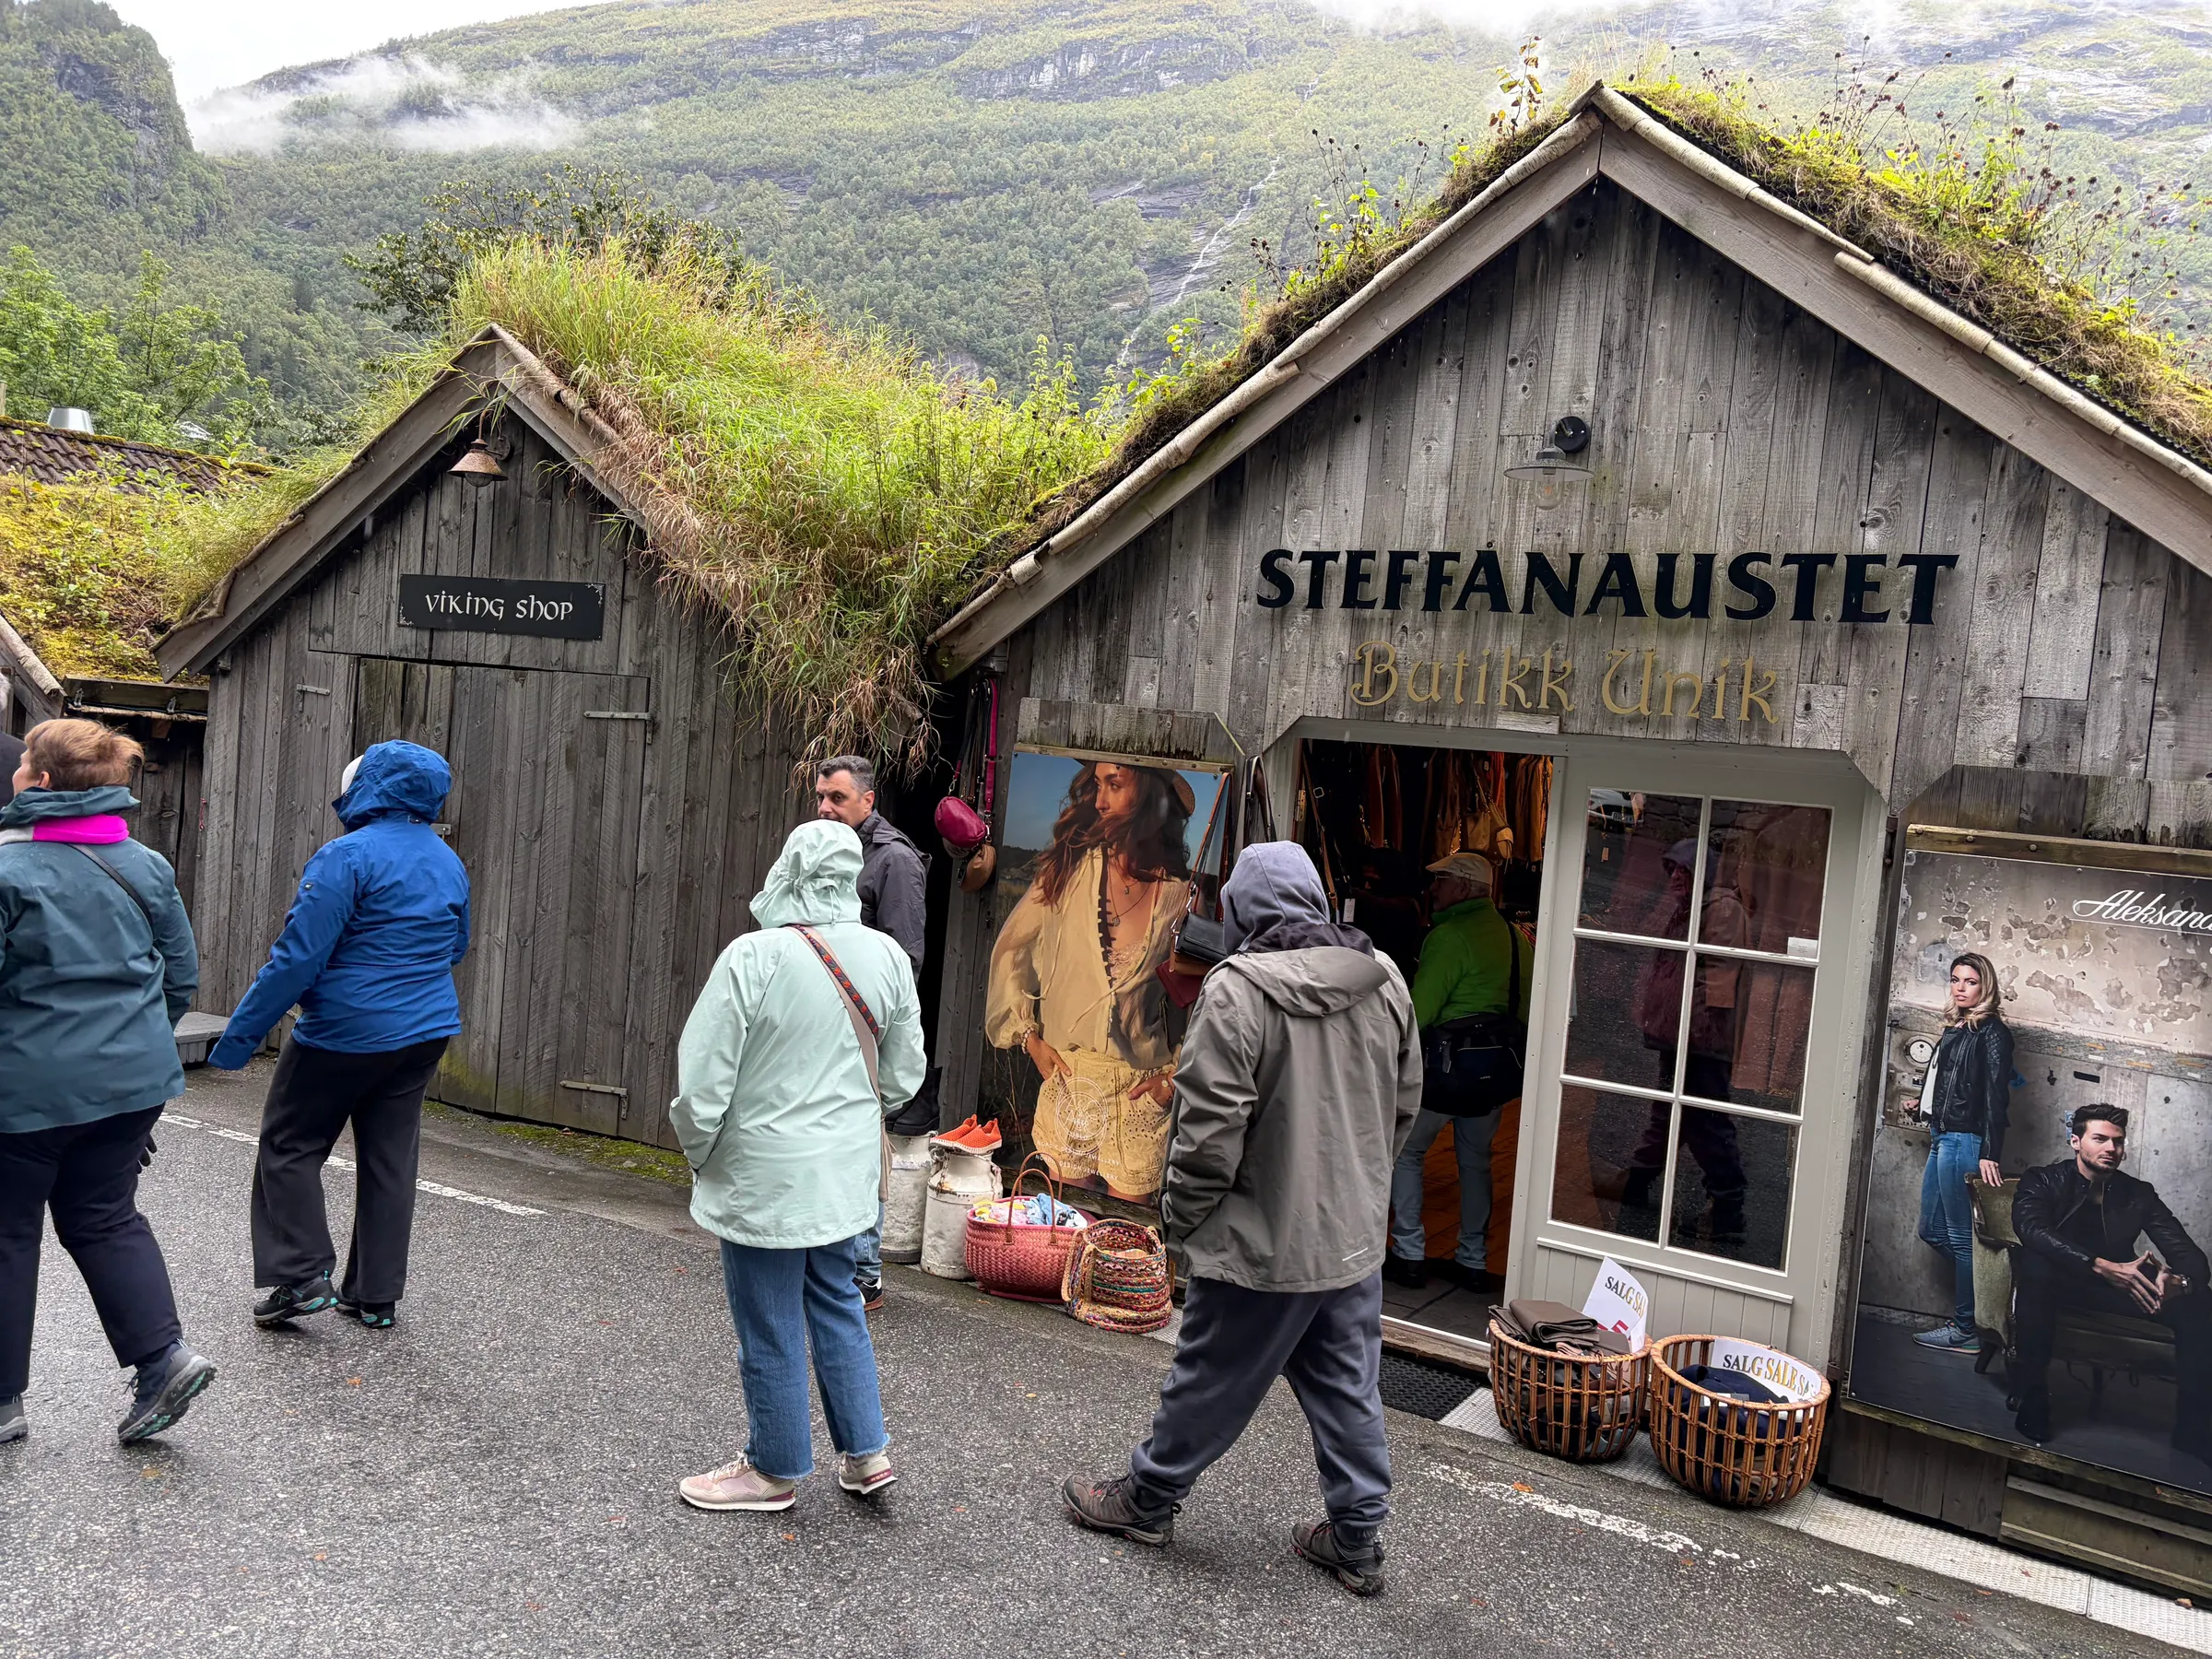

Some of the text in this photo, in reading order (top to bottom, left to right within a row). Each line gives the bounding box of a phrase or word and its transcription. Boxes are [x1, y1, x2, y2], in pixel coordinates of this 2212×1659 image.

[1255, 549, 1959, 626] STEFFANAUSTET
[1349, 640, 1780, 724] Butikk Unik
[1605, 1276, 1635, 1305] SALG
[1723, 1354, 1764, 1378] SALG
[1764, 1358, 1798, 1392] SALE
